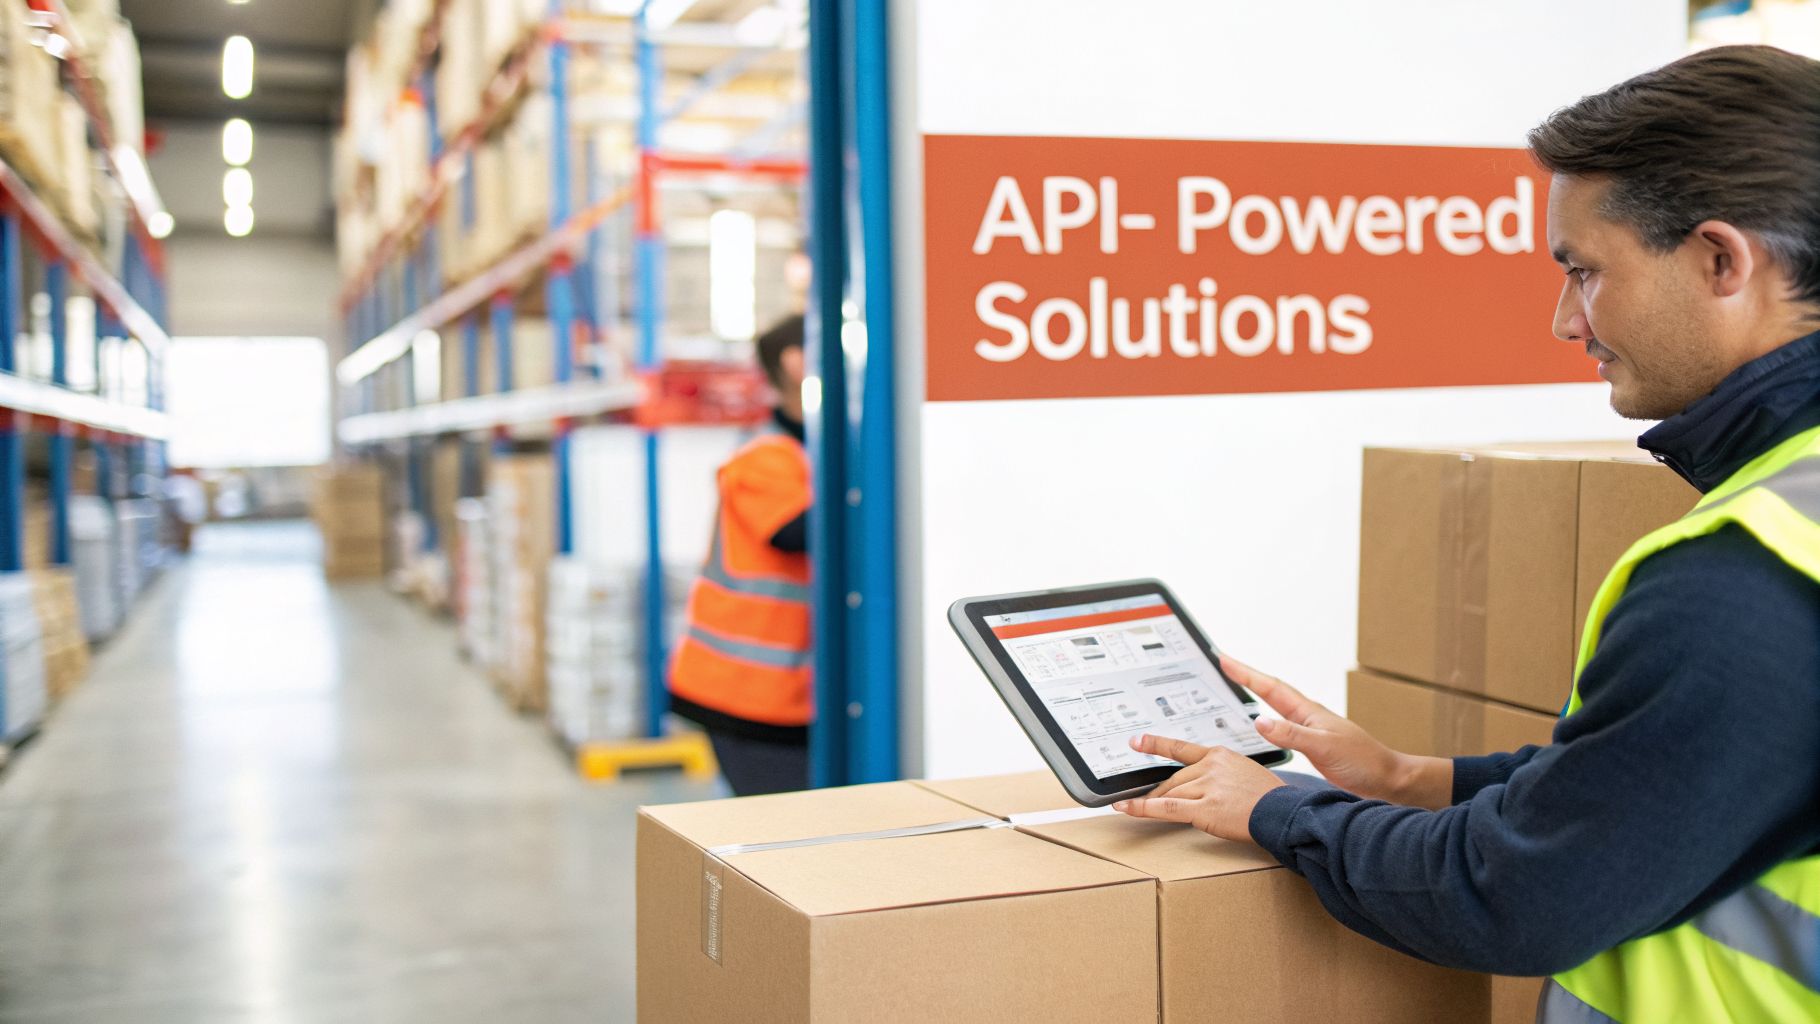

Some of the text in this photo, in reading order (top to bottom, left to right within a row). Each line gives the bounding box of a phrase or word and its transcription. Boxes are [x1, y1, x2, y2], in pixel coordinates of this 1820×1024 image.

[972, 175, 1536, 256] API- Powered
[974, 276, 1374, 362] Solutions
